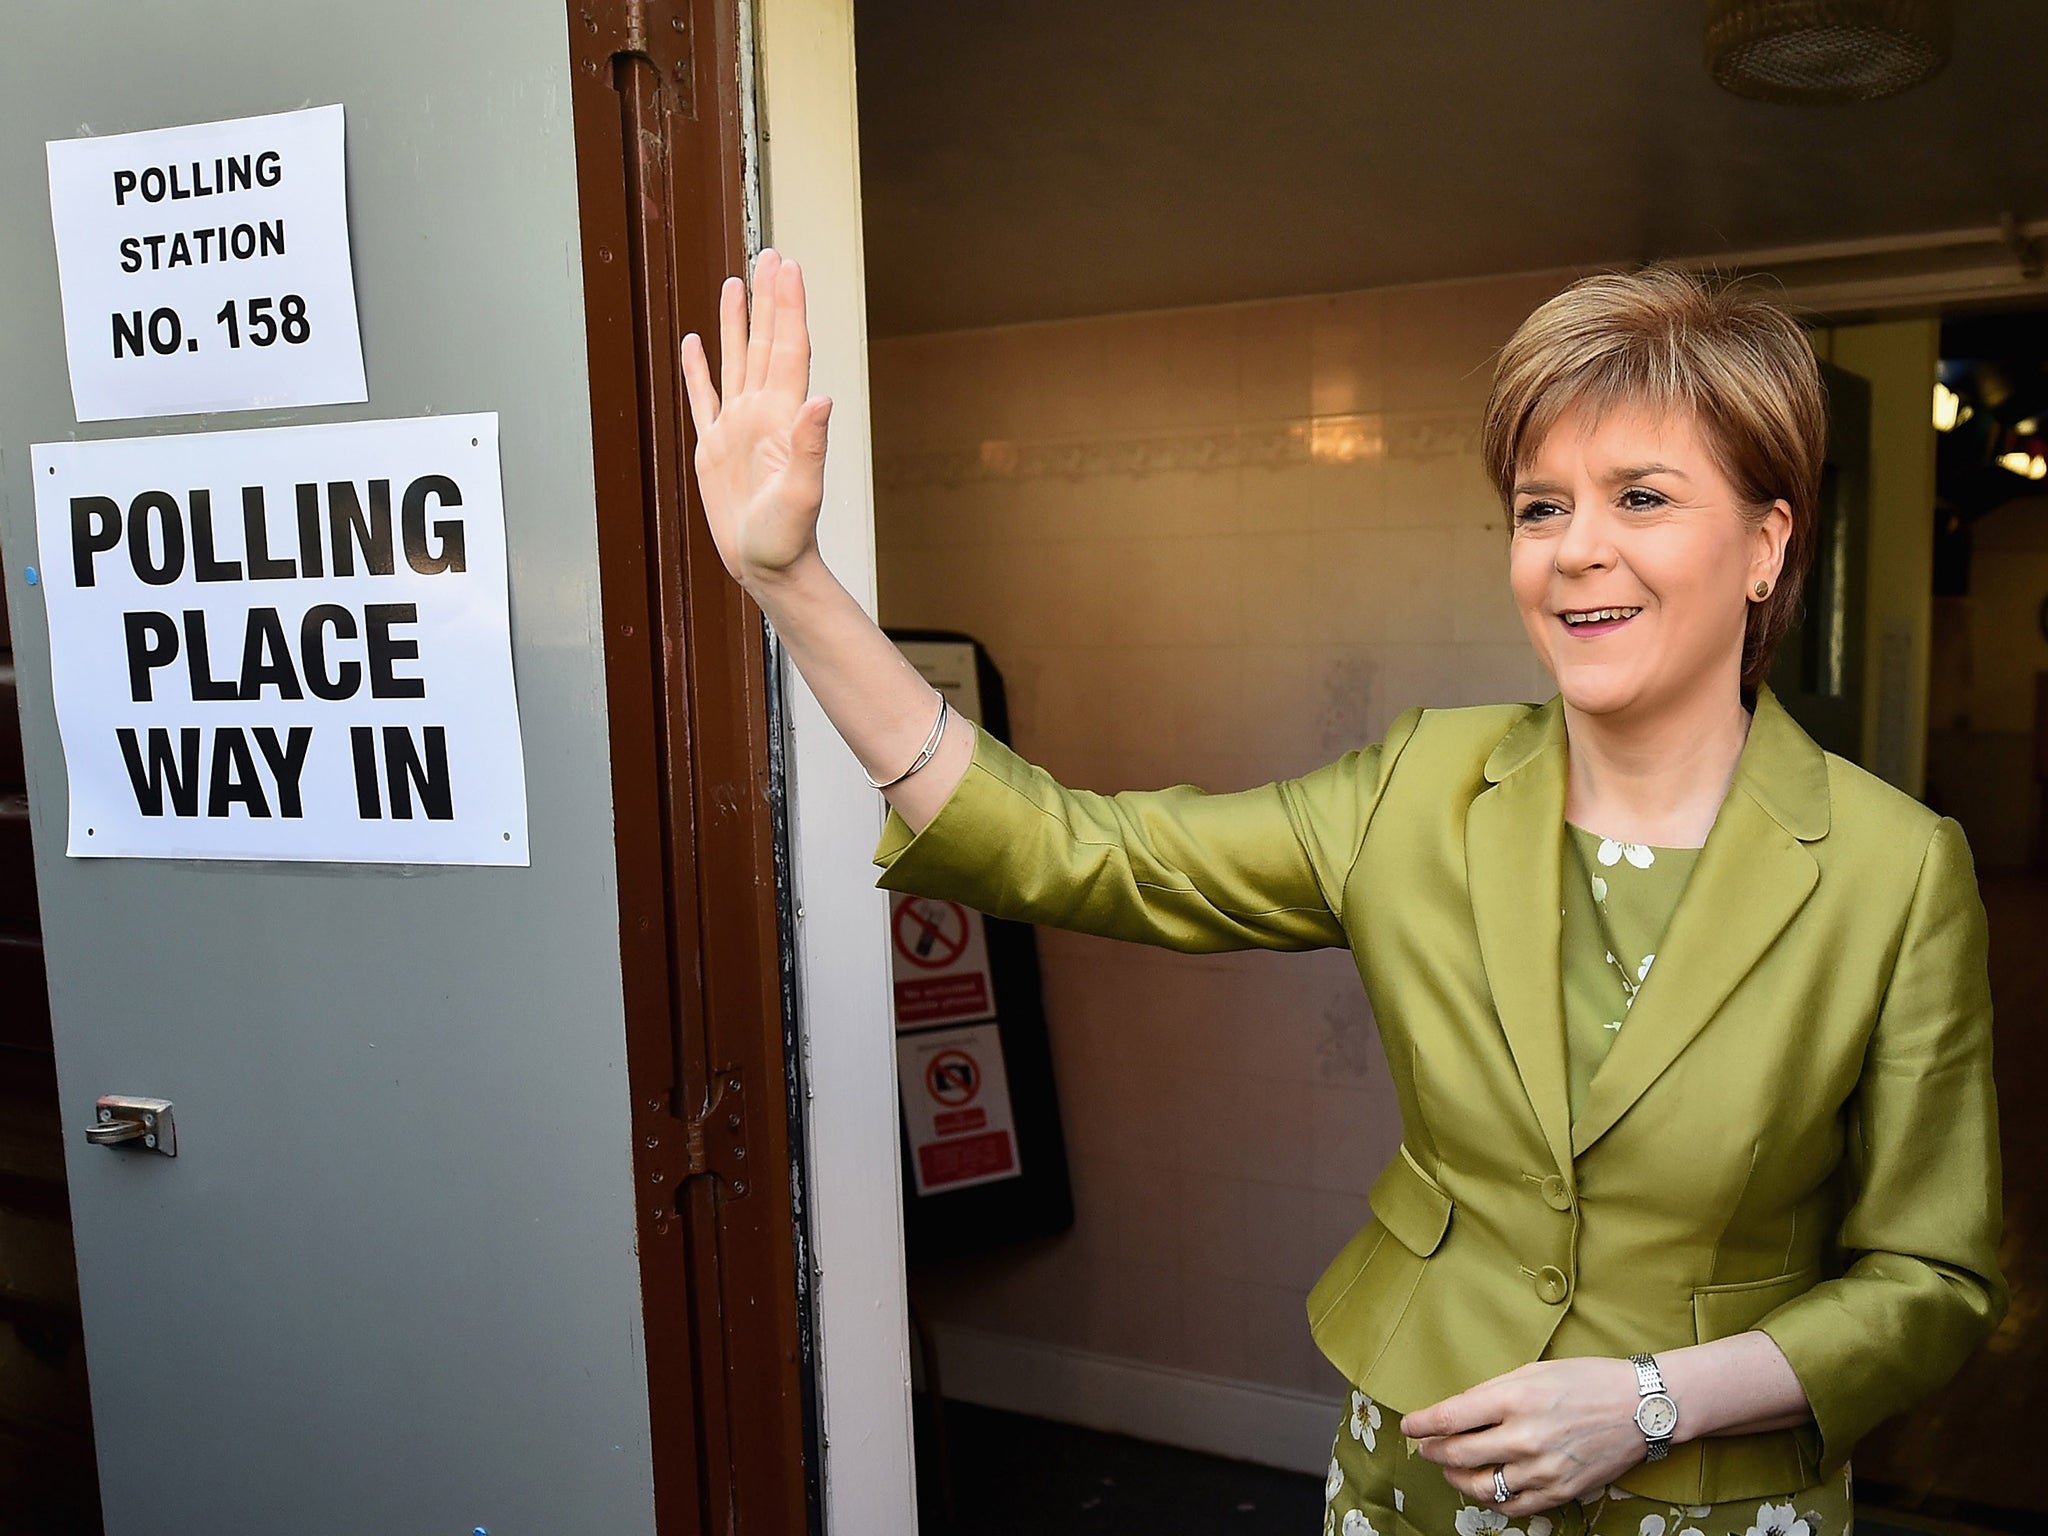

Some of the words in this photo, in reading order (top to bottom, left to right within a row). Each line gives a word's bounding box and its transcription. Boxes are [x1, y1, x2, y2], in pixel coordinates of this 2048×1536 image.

[114, 151, 282, 205] POLLING
[120, 219, 285, 273] STATION
[112, 307, 199, 359] NO.
[216, 294, 311, 349] 158
[70, 475, 467, 588] POLLING
[124, 603, 426, 703] PLACE
[116, 727, 313, 819] WAY
[350, 727, 454, 821] IN
